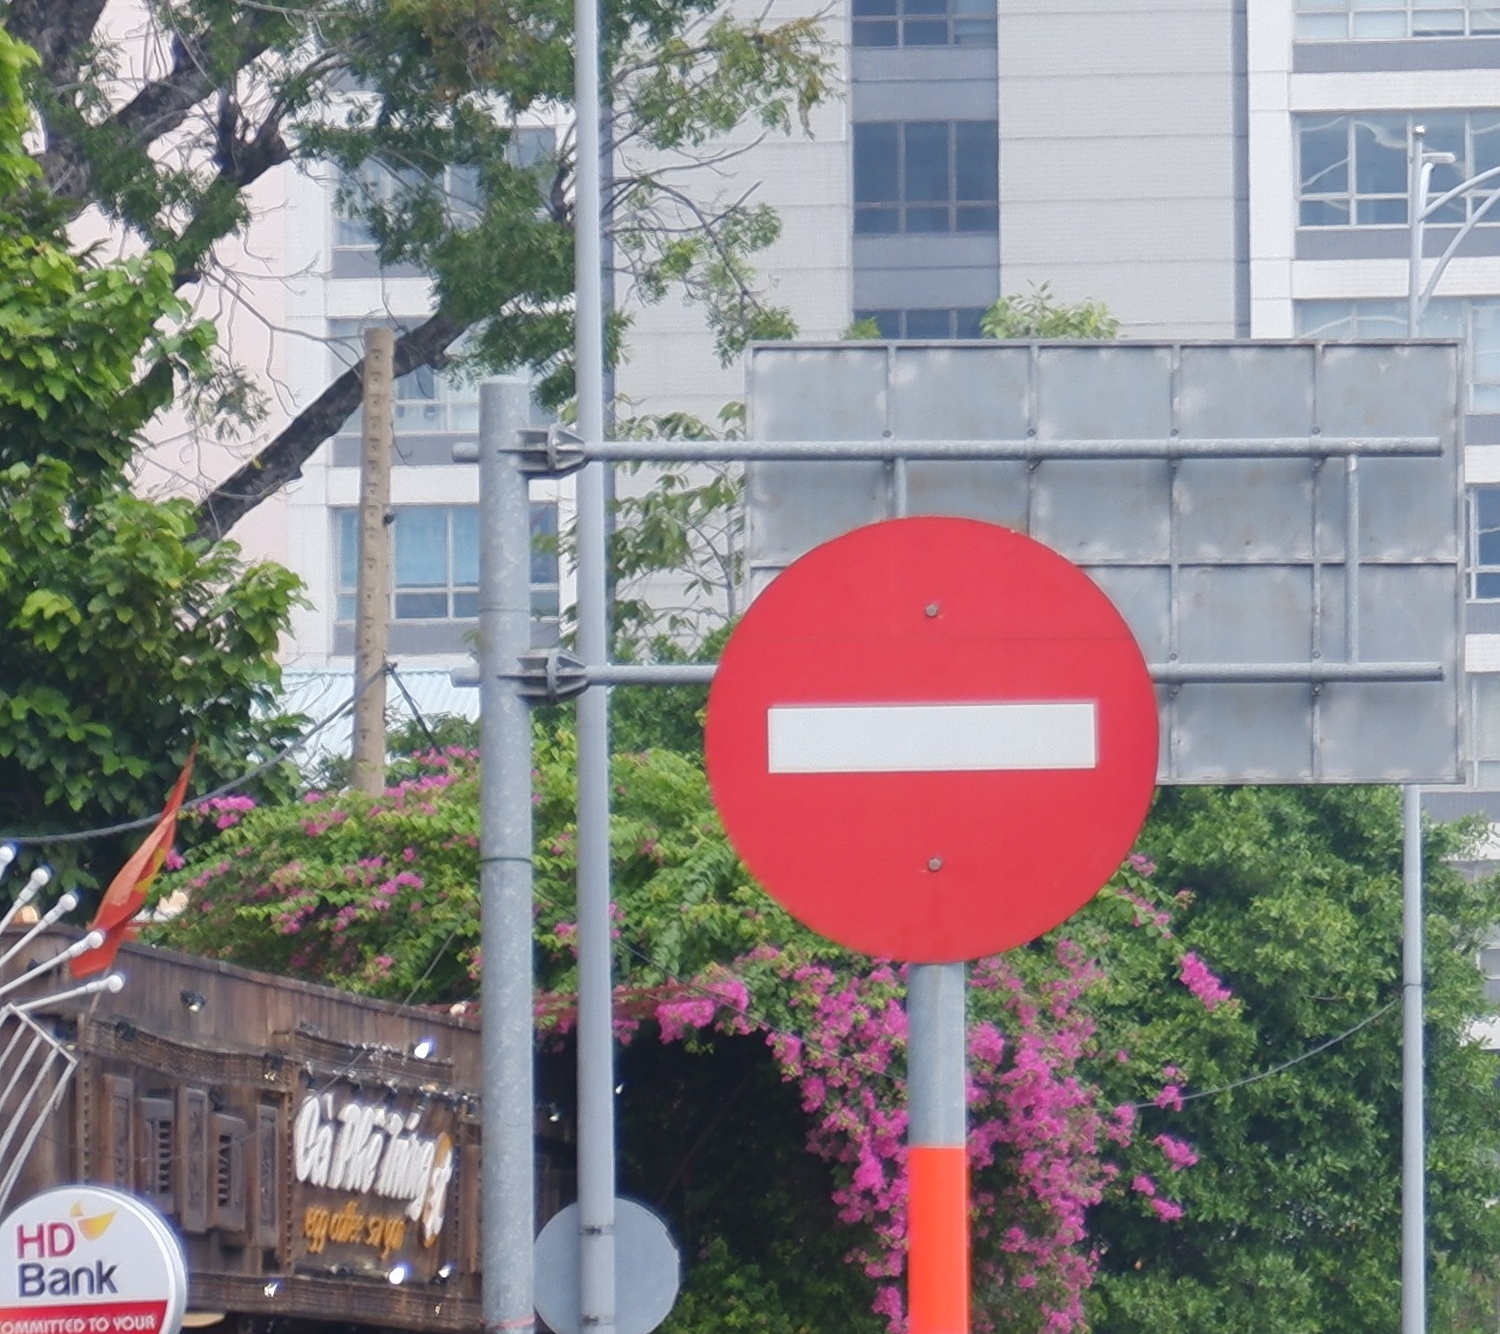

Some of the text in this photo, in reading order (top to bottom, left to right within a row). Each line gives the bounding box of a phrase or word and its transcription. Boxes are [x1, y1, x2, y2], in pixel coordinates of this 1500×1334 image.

[17, 1223, 76, 1259] HD
[18, 1260, 118, 1297] Bank
[88, 1317, 110, 1333] TO
[113, 1315, 156, 1331] YOUR
